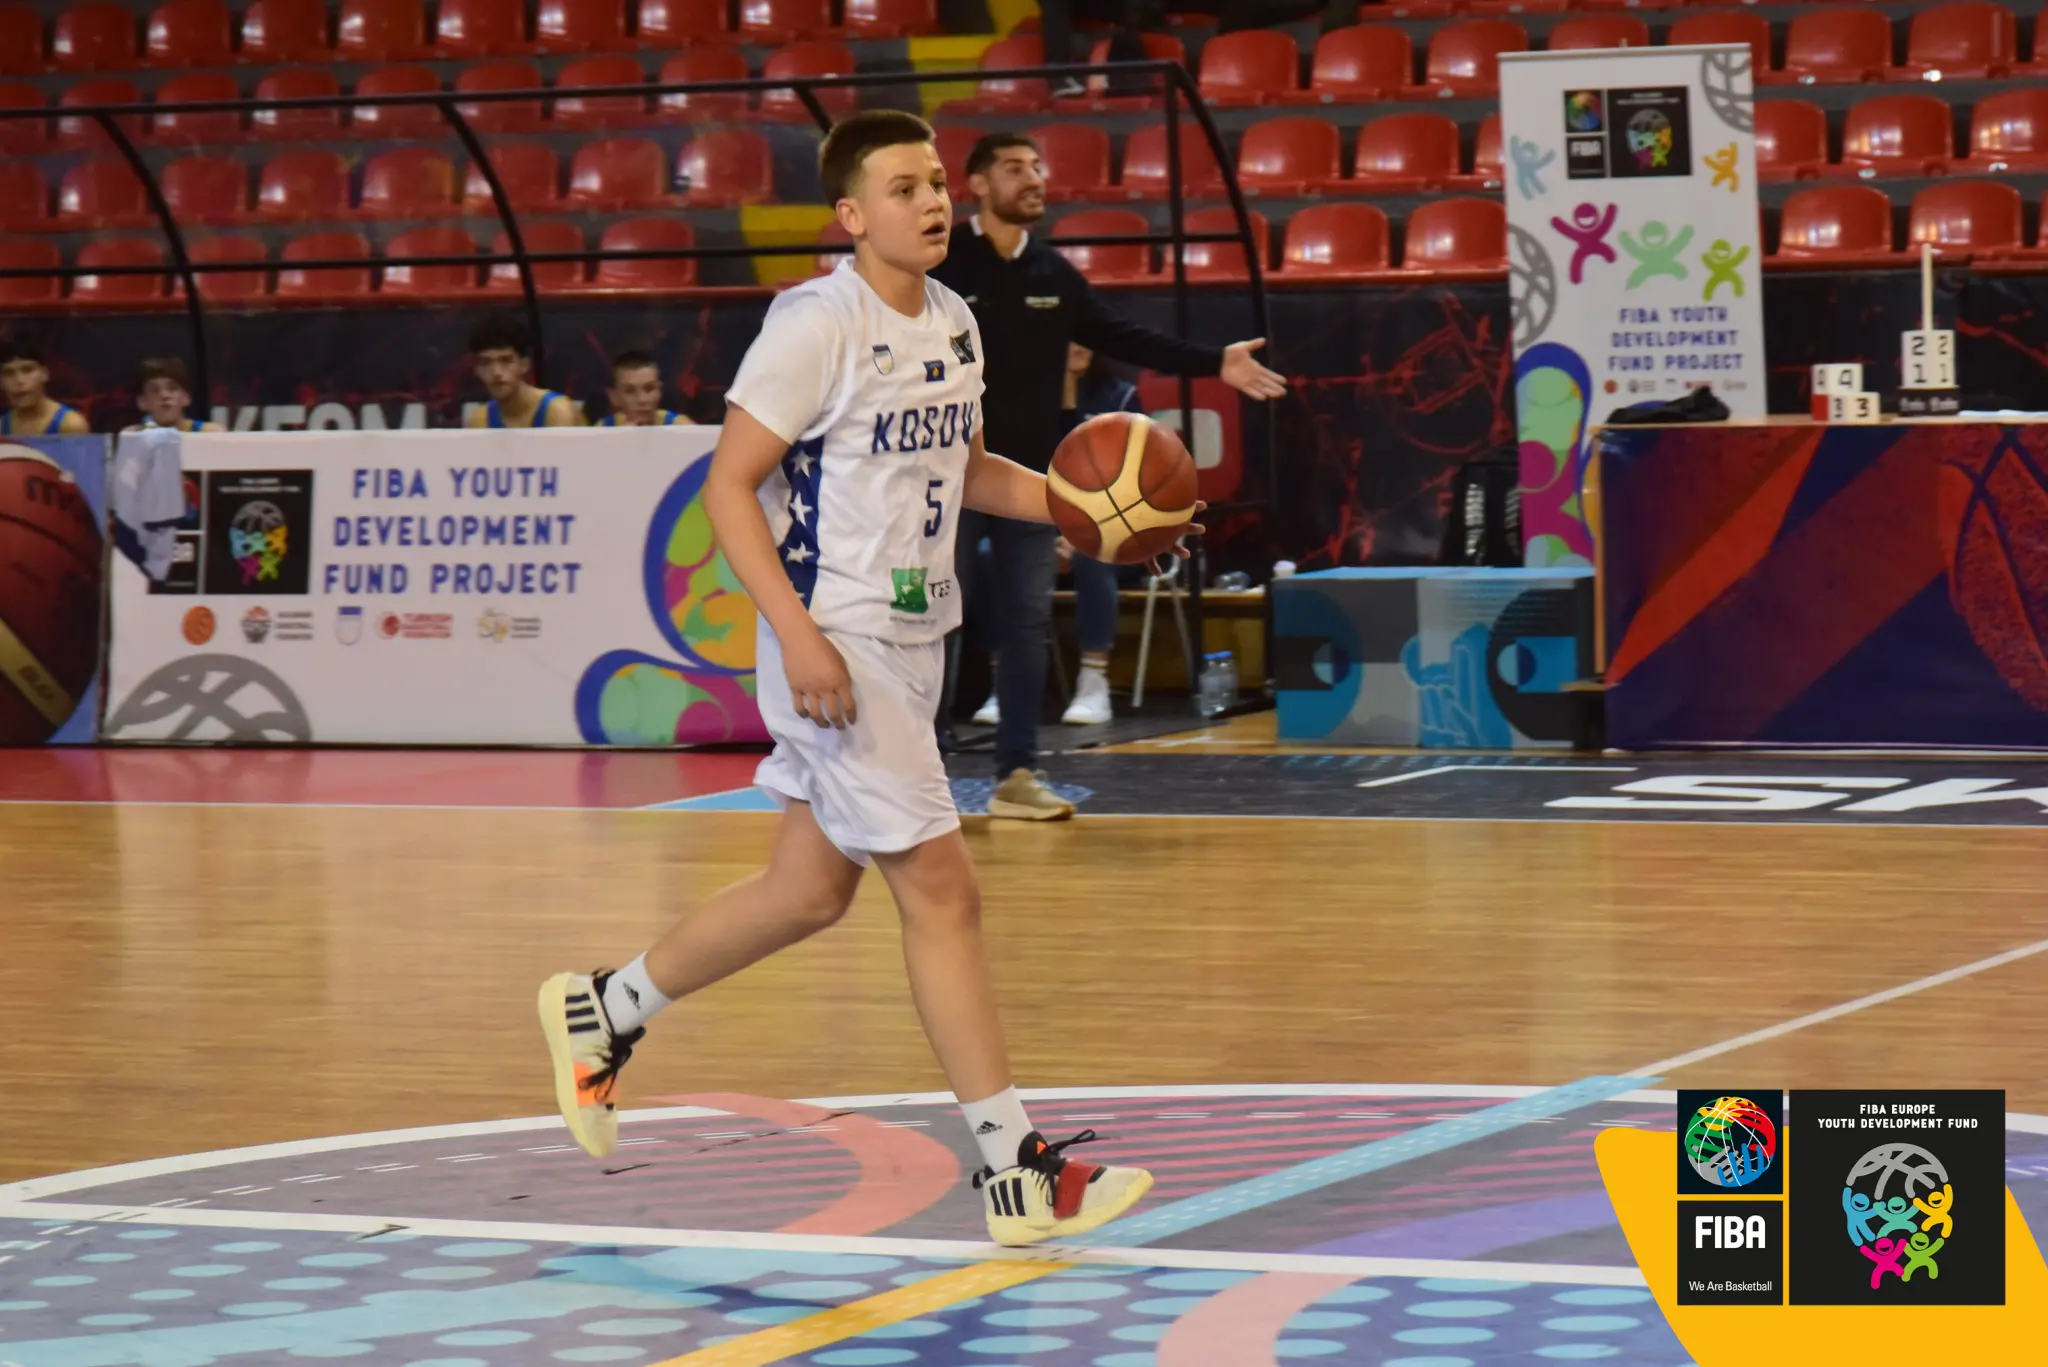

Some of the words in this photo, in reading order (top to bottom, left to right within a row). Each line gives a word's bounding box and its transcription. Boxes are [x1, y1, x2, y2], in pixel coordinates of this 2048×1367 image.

[1619, 306, 1660, 324] FIBA
[1670, 305, 1728, 323] YOUTH
[1611, 329, 1739, 348] DEVELOPMENT
[1911, 335, 1926, 356] 2
[1607, 354, 1655, 371] FUND
[1664, 352, 1744, 370] PROJECT
[1838, 368, 1854, 389] 4
[1913, 363, 1927, 384] 1
[1856, 397, 1871, 418] 3
[353, 468, 428, 499] FIBA
[450, 467, 558, 498] YOUTH
[923, 479, 943, 538] 5
[334, 514, 575, 547] DEVELOPMENT
[324, 563, 408, 595] FUND
[430, 562, 582, 595] PROJECT
